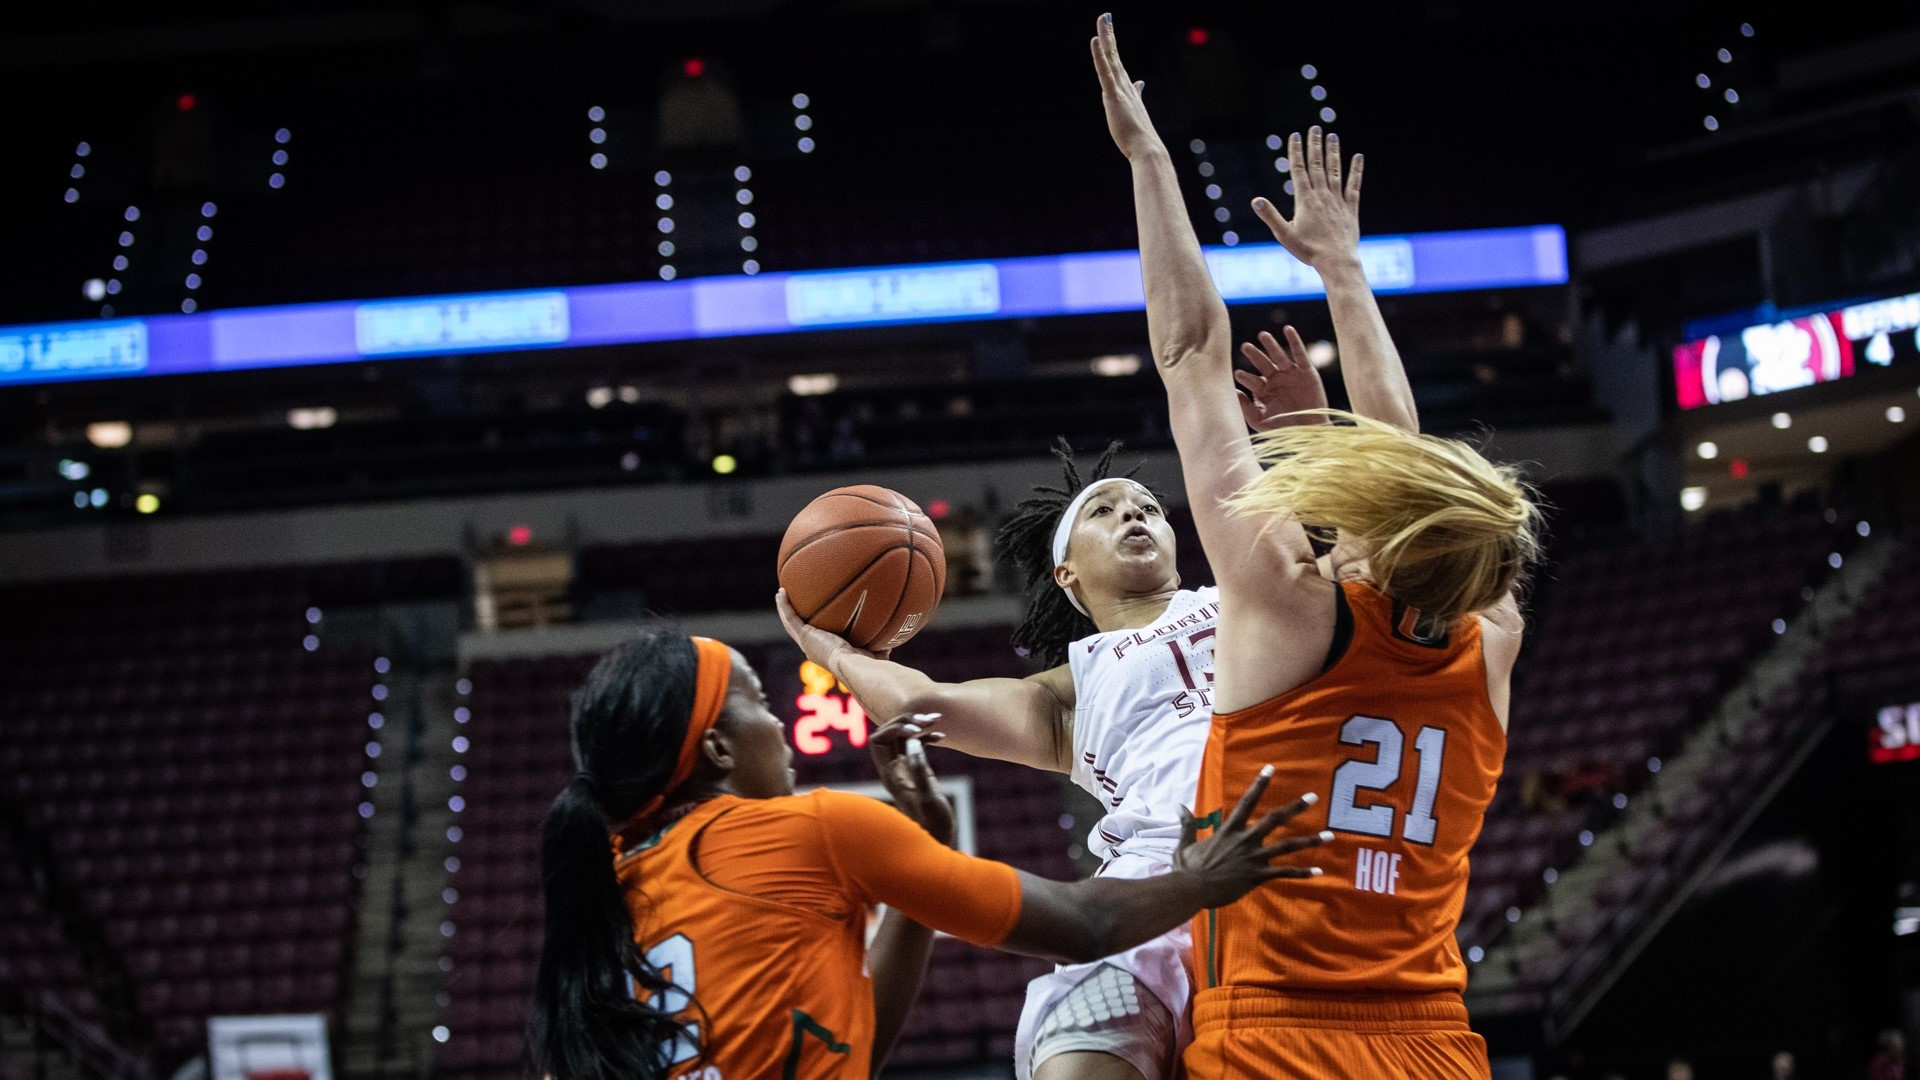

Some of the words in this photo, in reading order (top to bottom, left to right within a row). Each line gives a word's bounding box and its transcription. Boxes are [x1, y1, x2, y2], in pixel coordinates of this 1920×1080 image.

[794, 694, 868, 755] 24
[1326, 713, 1446, 846] 21
[1355, 847, 1402, 896] HOF
